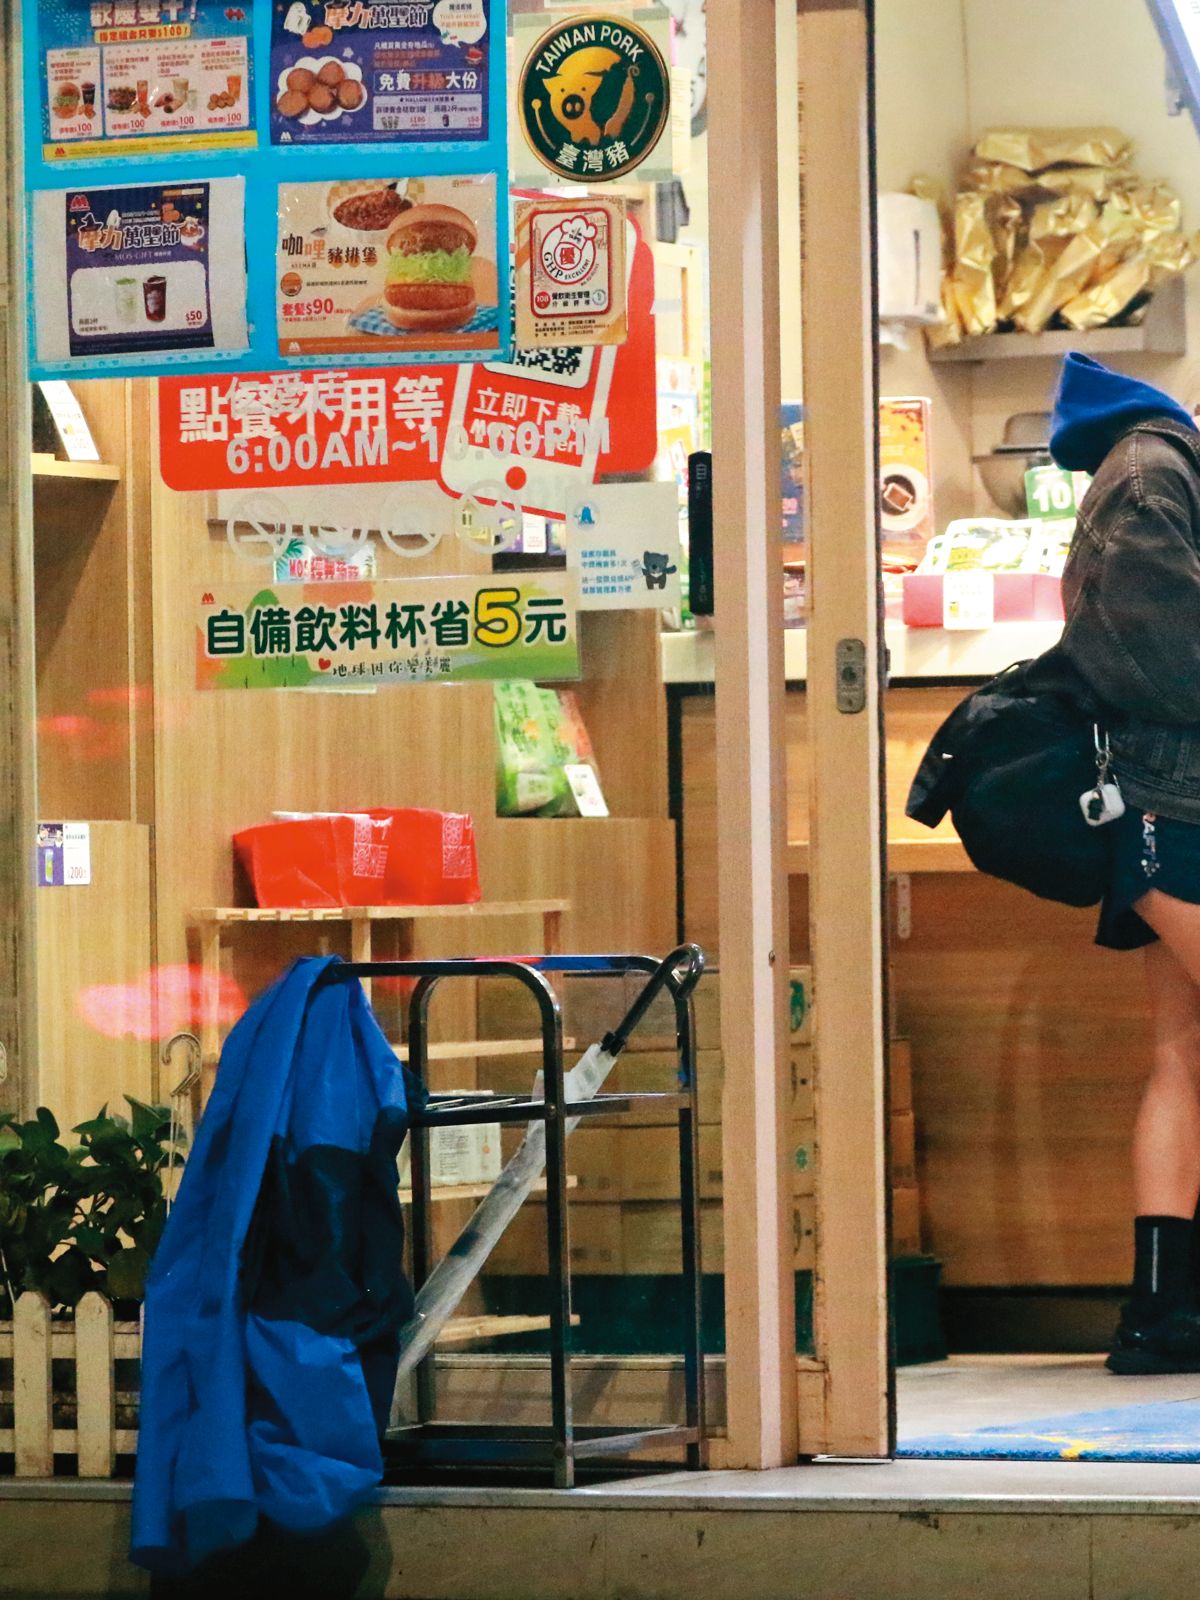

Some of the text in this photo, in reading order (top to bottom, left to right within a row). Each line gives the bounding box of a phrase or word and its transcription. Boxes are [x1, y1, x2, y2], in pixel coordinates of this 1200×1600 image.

[536, 25, 644, 73] TAIWAN PORK
[556, 141, 630, 172] 臺灣豬
[282, 233, 378, 264] 咖哩豬排堡
[544, 251, 563, 279] GHP
[207, 587, 567, 655] 自備飲料杯省5元
